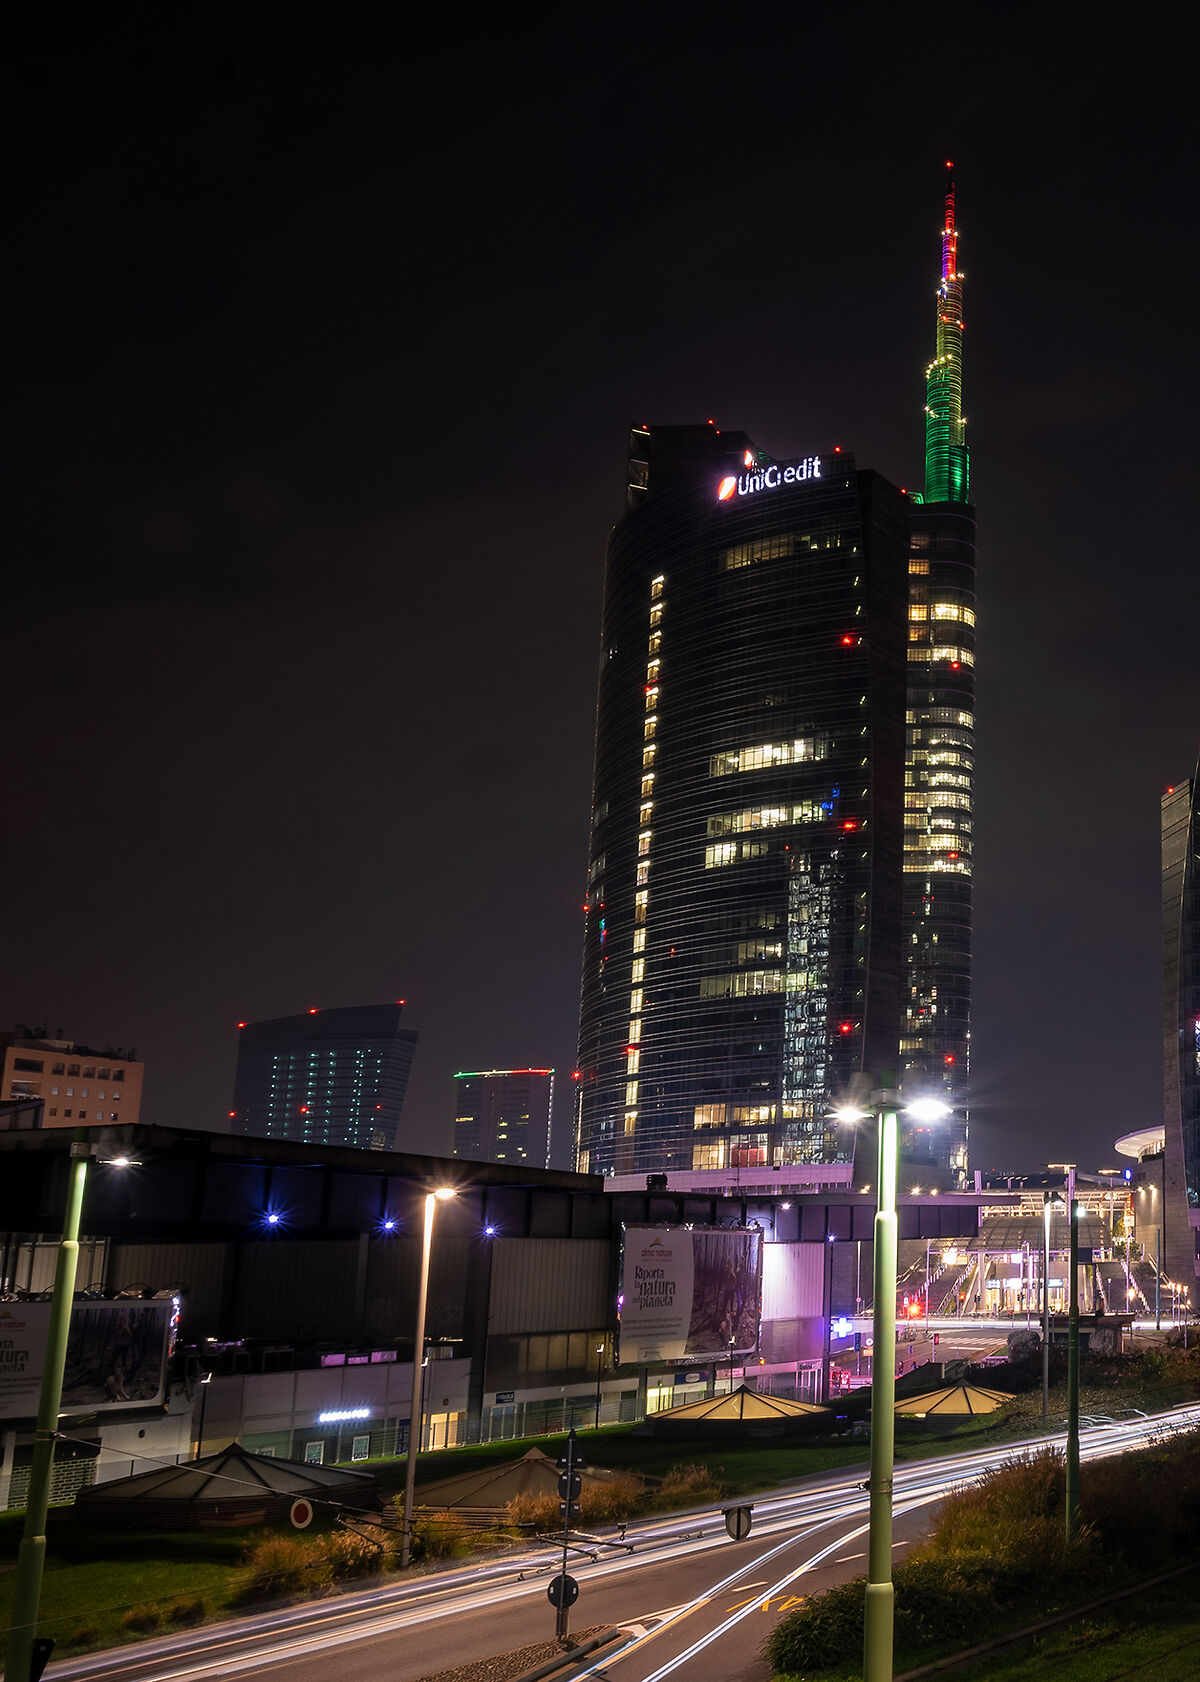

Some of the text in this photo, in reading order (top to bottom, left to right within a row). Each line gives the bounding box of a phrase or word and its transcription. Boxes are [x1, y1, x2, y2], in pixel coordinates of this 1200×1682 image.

[738, 456, 821, 495] UniCredit
[635, 1266, 665, 1280] Riporta
[640, 1280, 676, 1296] natura
[640, 1296, 673, 1311] pianeta
